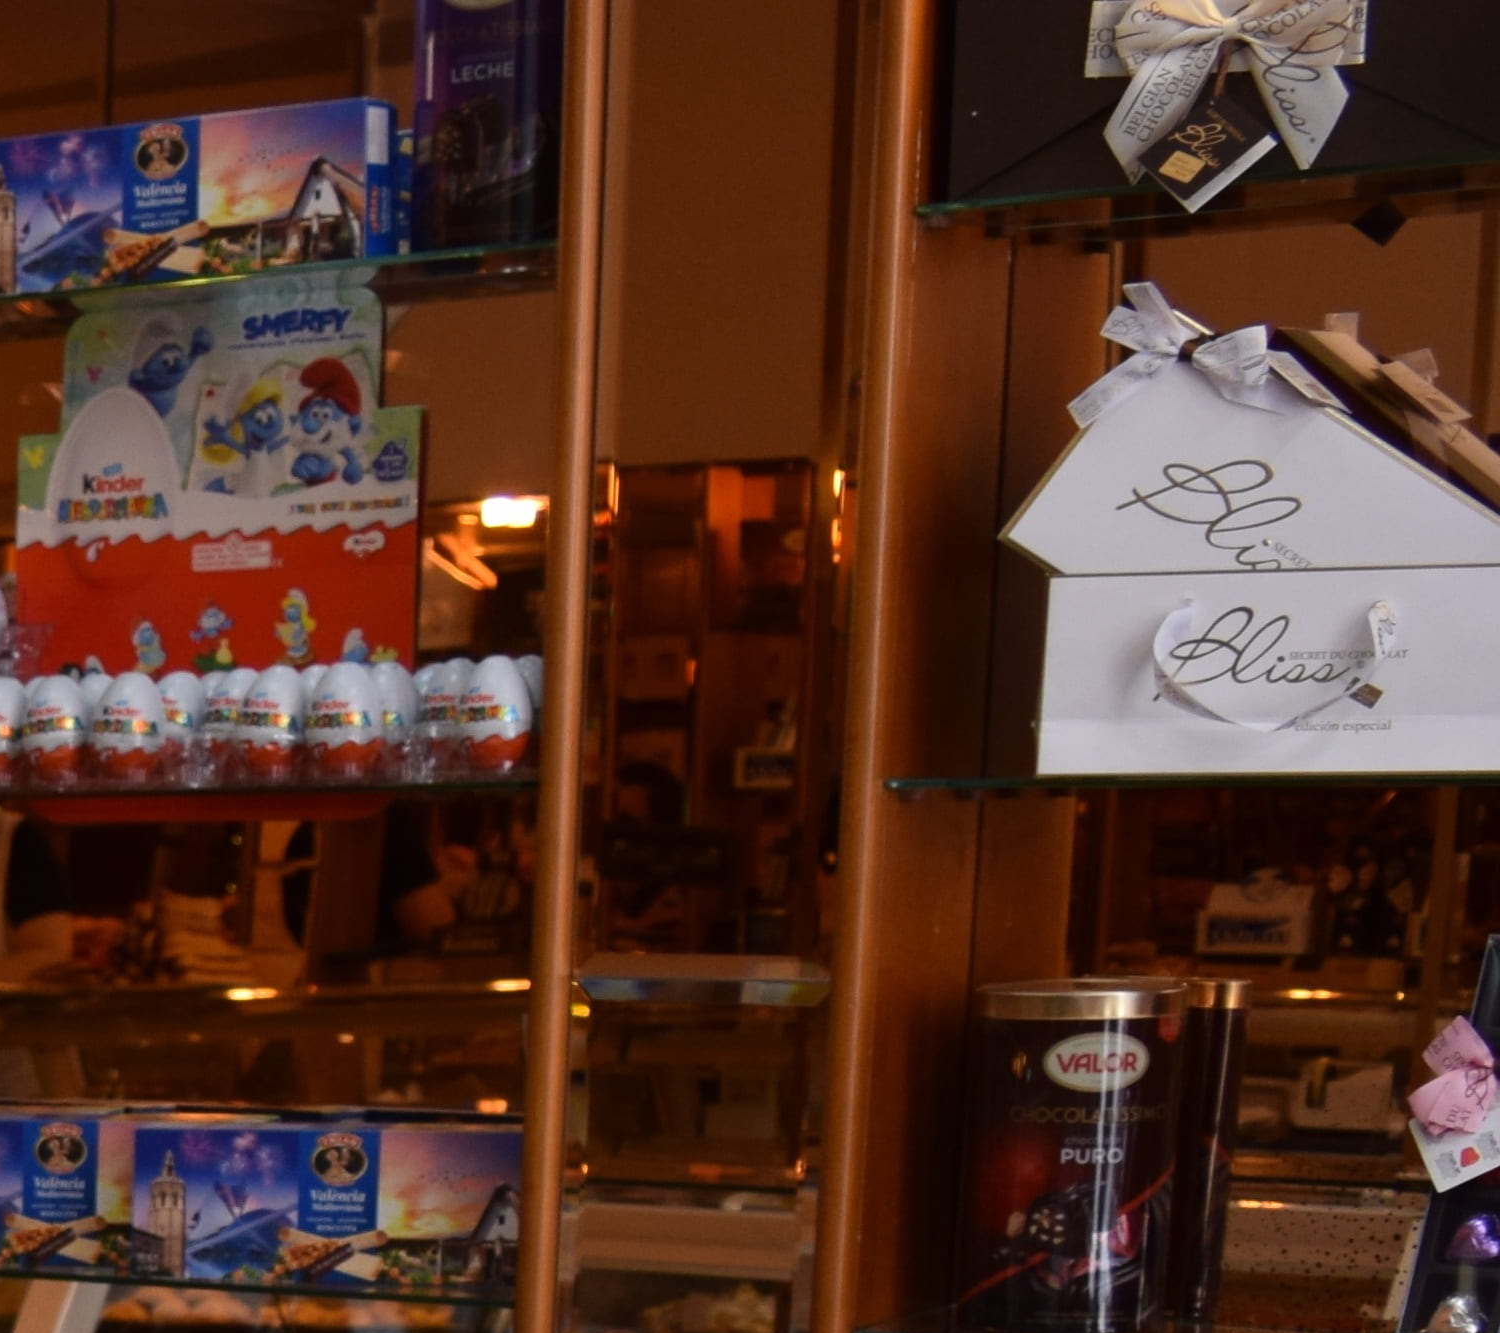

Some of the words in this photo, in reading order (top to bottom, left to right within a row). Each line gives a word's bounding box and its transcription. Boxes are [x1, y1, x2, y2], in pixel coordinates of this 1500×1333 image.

[451, 61, 515, 84] LECHE
[1122, 67, 1173, 138] BELGIAN
[243, 308, 352, 340] SMERFY
[83, 473, 144, 494] Kinder
[1288, 650, 1328, 661] SECRET
[1343, 719, 1393, 735] especial
[1056, 1052, 1138, 1074] VALOR
[1060, 1148, 1124, 1165] PURO
